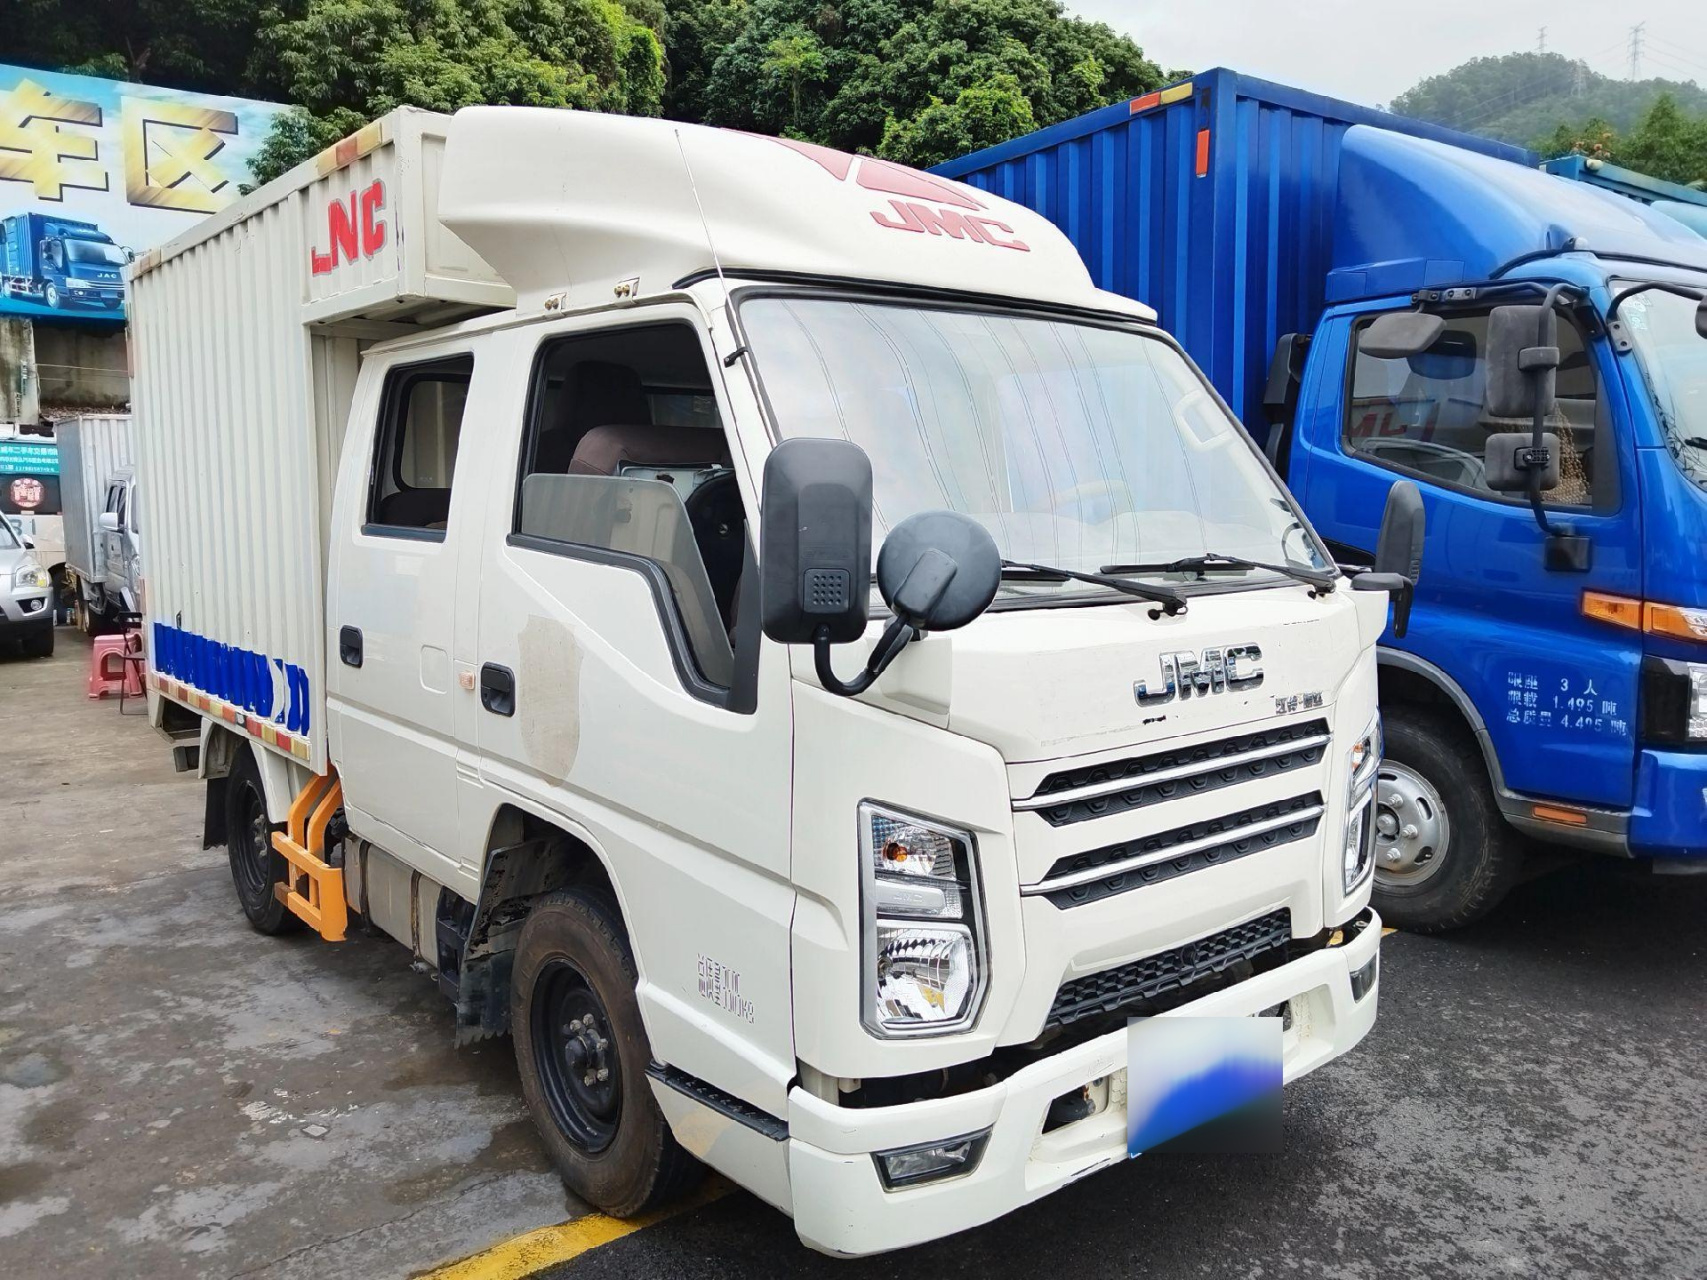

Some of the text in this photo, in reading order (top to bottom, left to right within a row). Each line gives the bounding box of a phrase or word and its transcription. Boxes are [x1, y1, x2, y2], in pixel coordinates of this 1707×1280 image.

[870, 199, 1031, 252] JMC
[1133, 641, 1265, 708] JMC
[1560, 678, 1569, 692] 3
[1583, 679, 1598, 696] 人
[1506, 708, 1553, 727] 总质量
[1602, 700, 1618, 716] 吨
